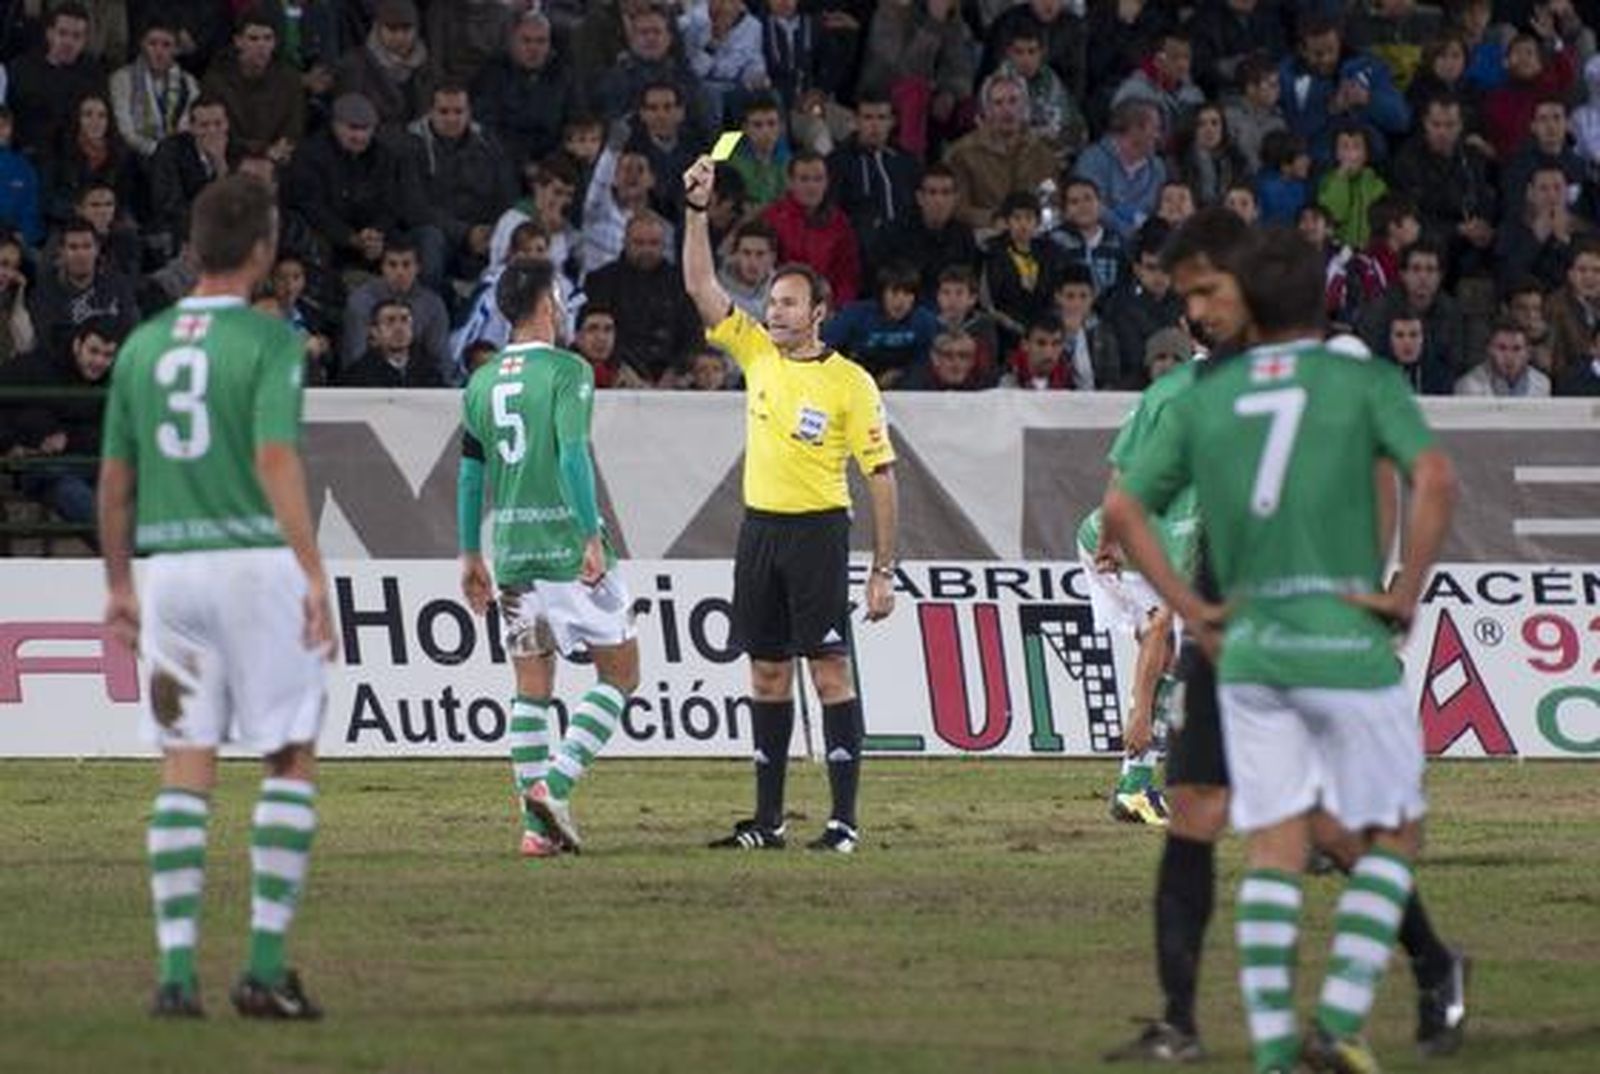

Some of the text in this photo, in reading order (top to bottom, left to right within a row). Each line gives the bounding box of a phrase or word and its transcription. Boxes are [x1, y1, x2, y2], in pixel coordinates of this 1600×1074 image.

[154, 347, 212, 460] 3
[491, 382, 526, 464] 5
[1234, 387, 1307, 518] 7
[346, 682, 751, 743] Autoción
